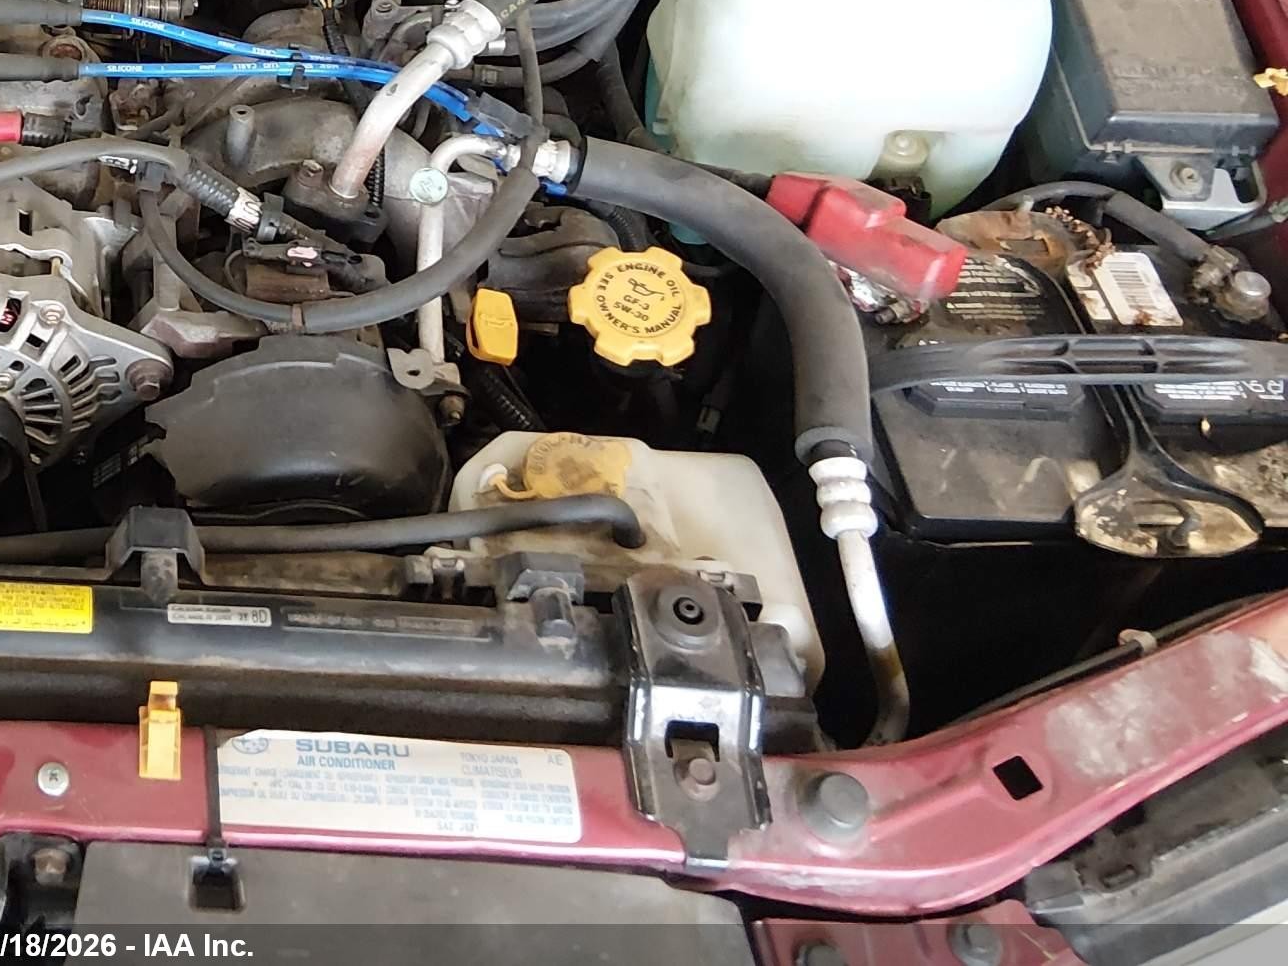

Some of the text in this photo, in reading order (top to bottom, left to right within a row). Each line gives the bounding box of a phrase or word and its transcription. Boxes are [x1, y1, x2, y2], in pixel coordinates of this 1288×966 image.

[617, 262, 681, 297] ENGINE OIL
[596, 272, 682, 334] SEE OWNER'S MANUAL
[613, 301, 649, 322] 5W-30
[296, 738, 410, 758] SUBARU
[297, 755, 396, 771] AIR CONDITIONER
